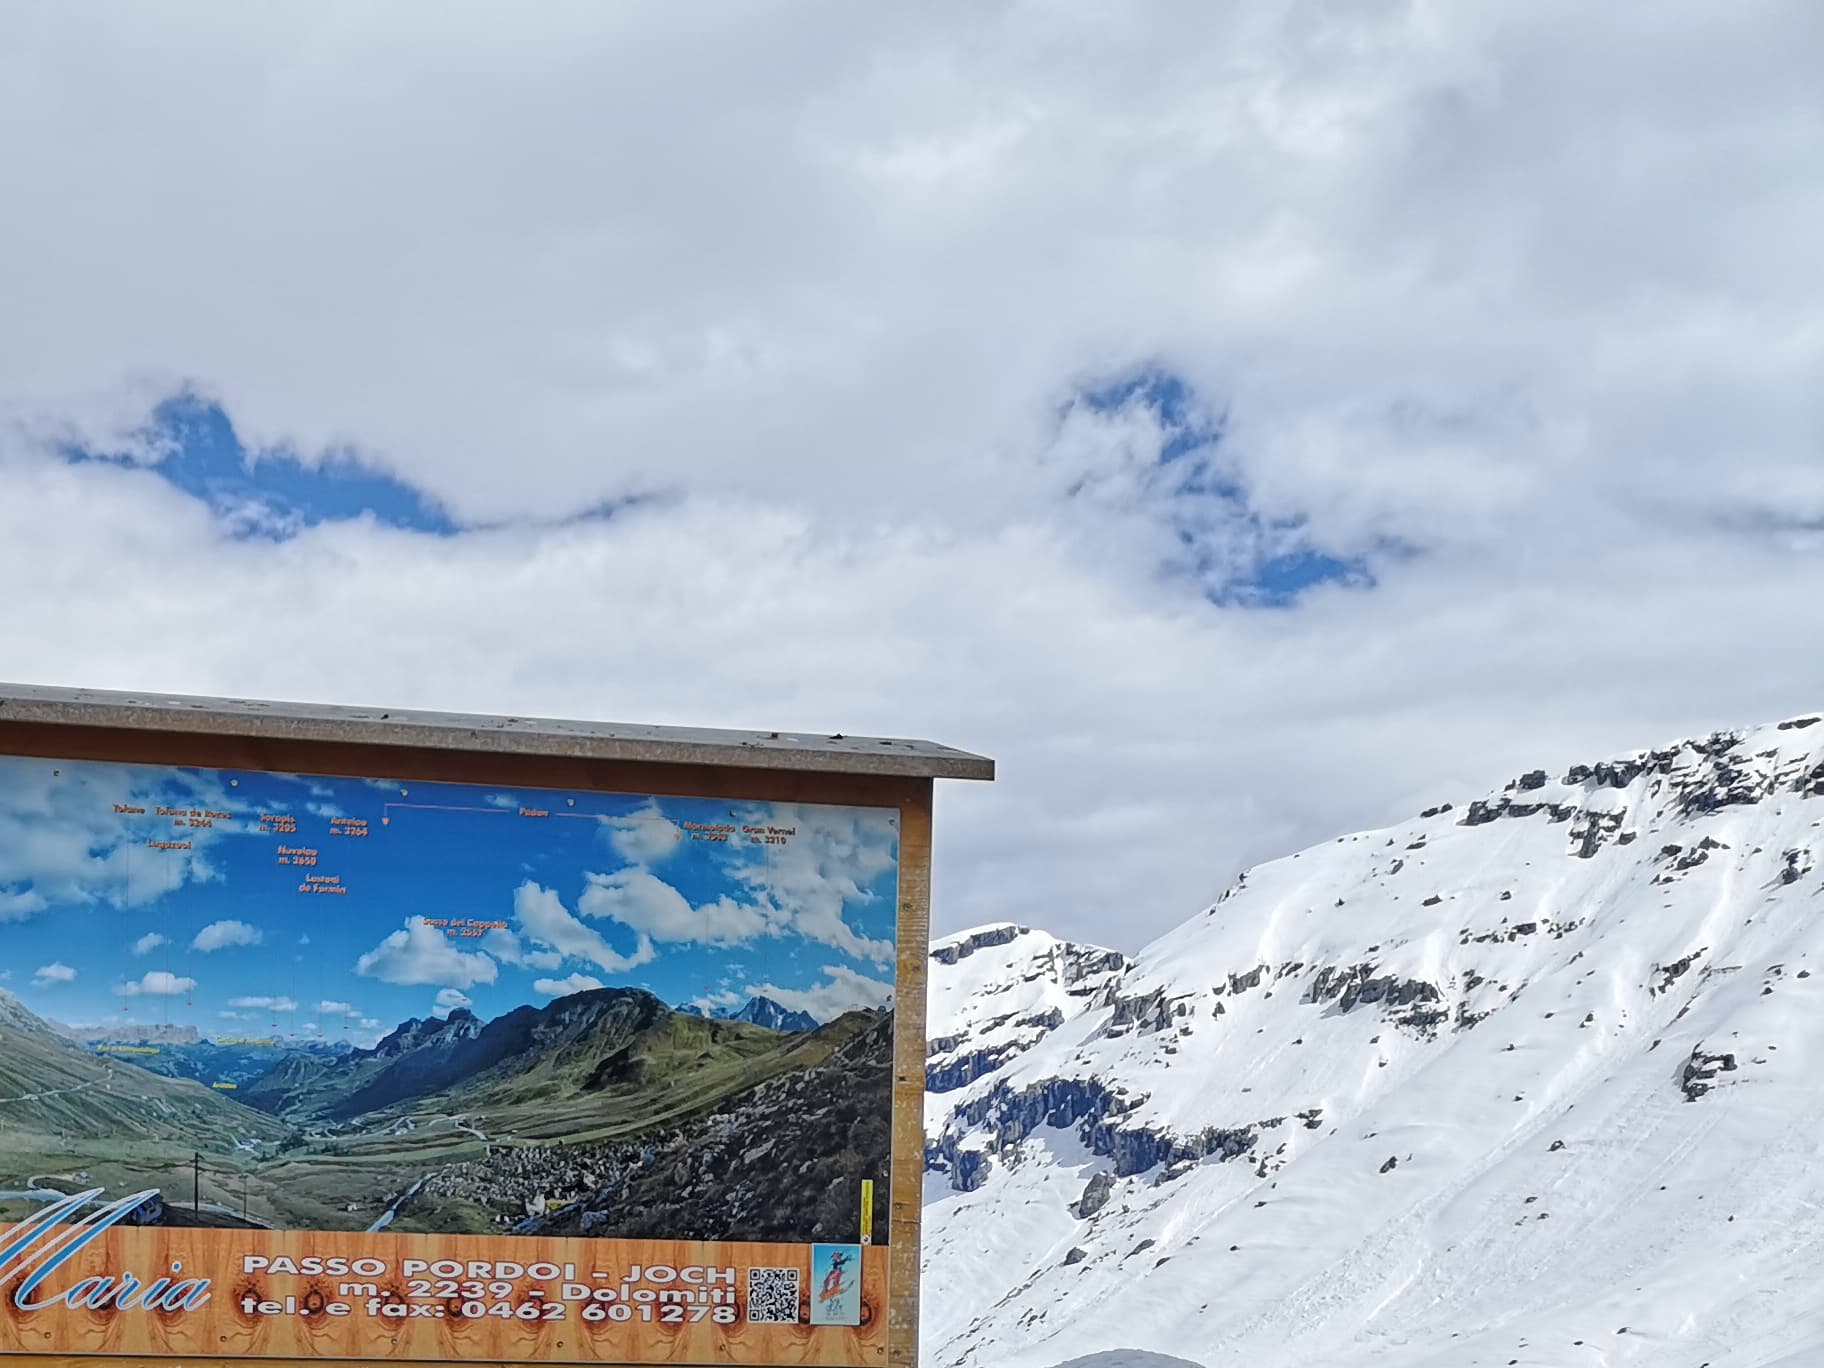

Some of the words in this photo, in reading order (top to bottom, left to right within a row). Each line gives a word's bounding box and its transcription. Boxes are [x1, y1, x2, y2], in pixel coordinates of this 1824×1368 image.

[243, 1255, 386, 1277] PASSO
[402, 1259, 576, 1281] PORDOI
[621, 1263, 736, 1285] JOCH
[339, 1282, 391, 1298] m.
[407, 1280, 513, 1299] 2239
[561, 1282, 736, 1304] Dolomiti
[241, 1296, 310, 1316] tel.
[326, 1301, 351, 1316] e
[366, 1297, 445, 1318] fax:
[461, 1300, 567, 1320] 0462
[581, 1302, 737, 1324] 601278
